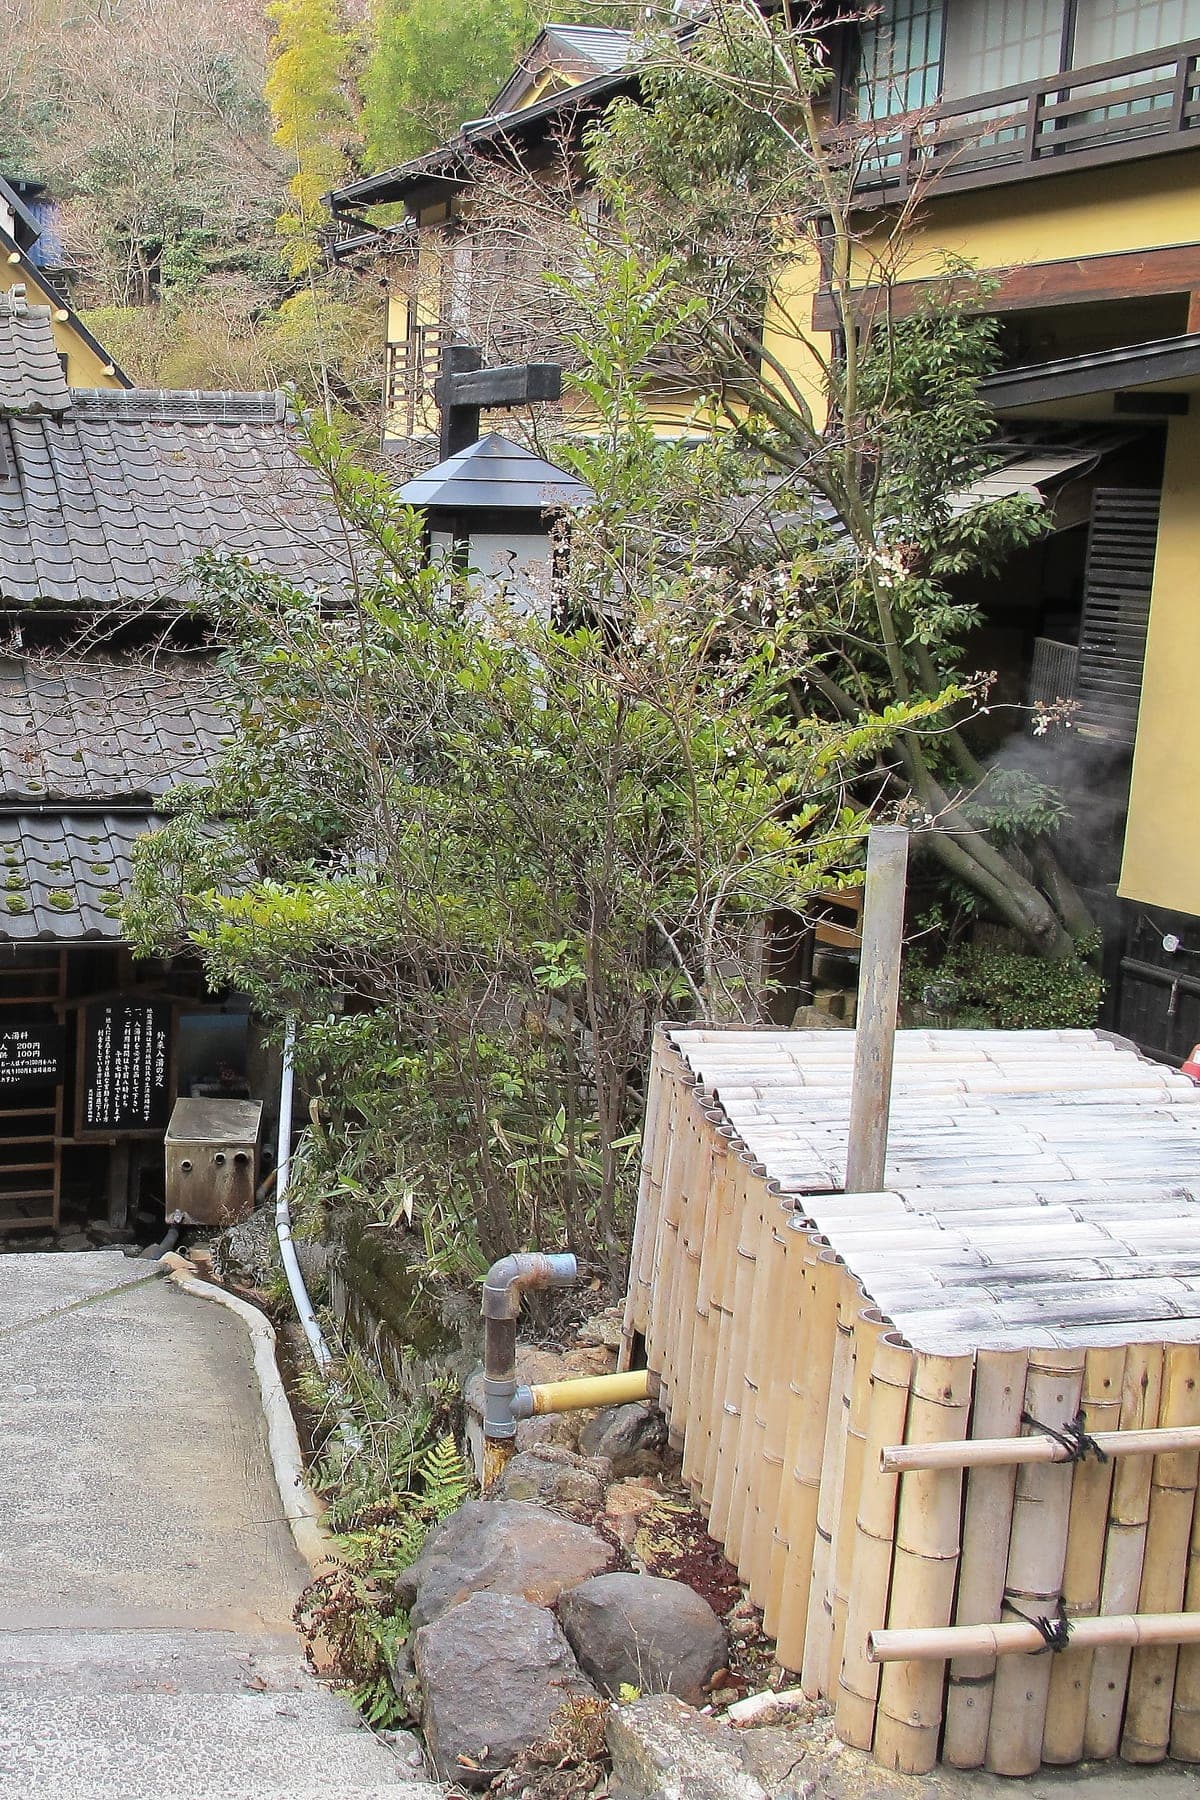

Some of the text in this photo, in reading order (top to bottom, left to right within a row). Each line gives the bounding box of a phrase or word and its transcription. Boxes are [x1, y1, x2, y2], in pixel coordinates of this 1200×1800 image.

[3, 1031, 29, 1041] 入湯料
[16, 1041, 41, 1050] 200円
[16, 1050, 41, 1058] 100円
[155, 1031, 166, 1088] 外来入湯の方へ
